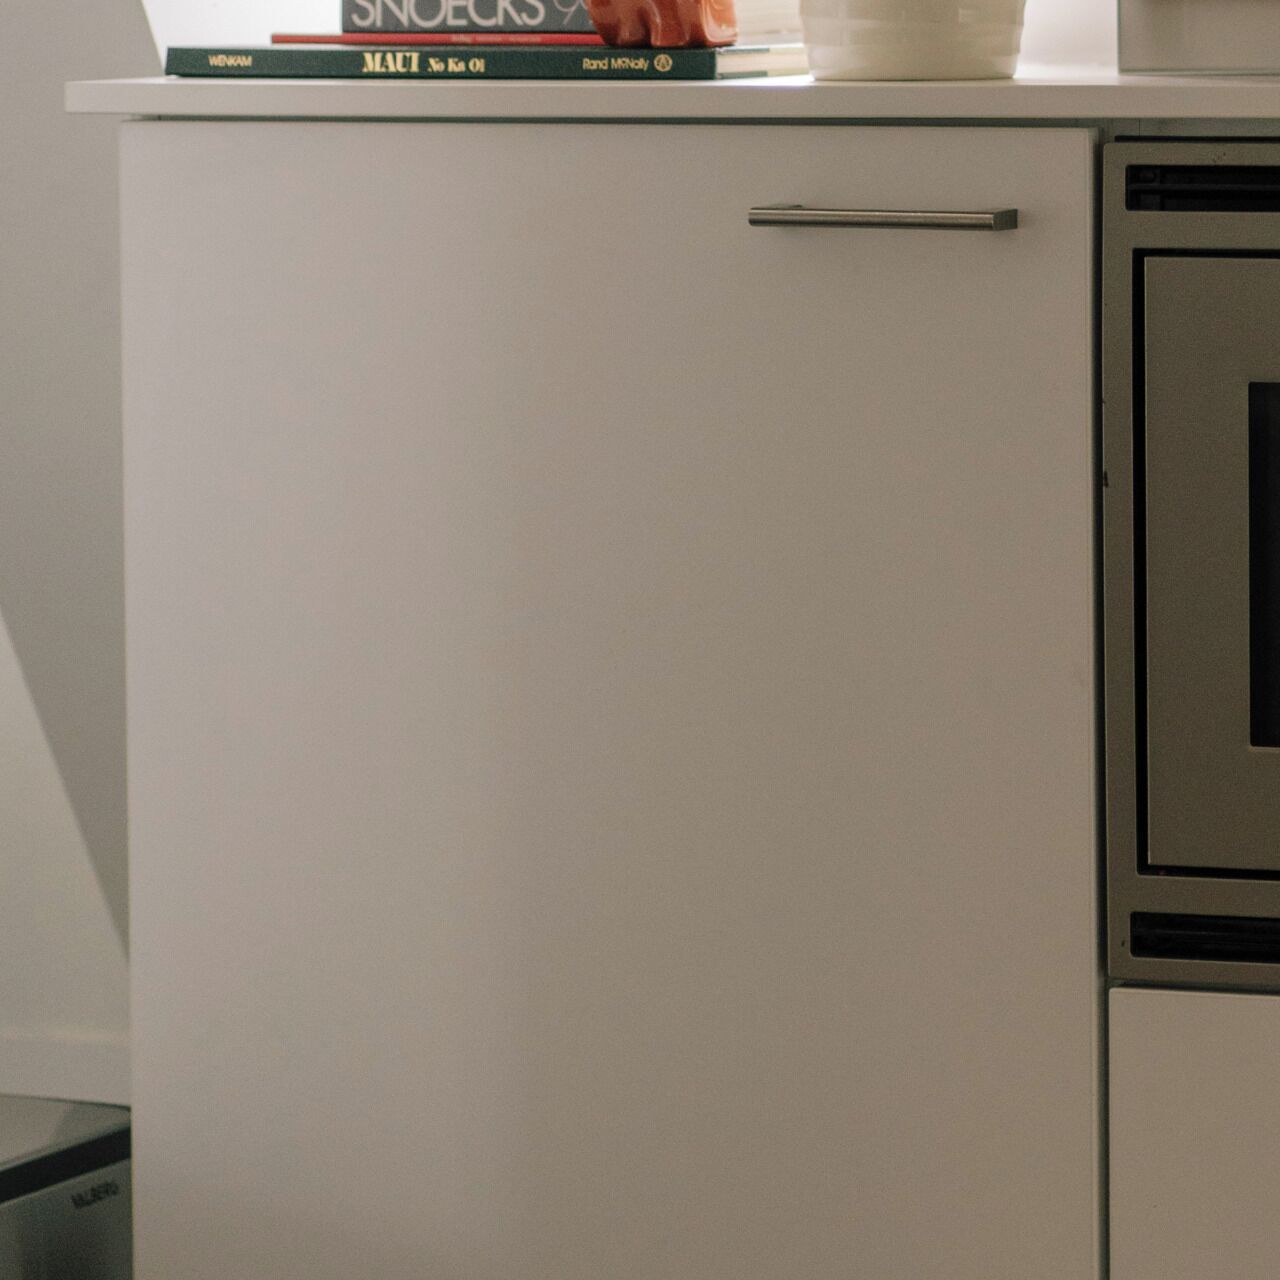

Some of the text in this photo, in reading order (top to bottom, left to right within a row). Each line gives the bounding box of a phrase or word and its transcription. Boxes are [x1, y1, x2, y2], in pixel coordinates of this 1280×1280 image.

[362, 52, 419, 73] MAUI
[427, 57, 445, 72] No
[582, 58, 608, 71] Rand
